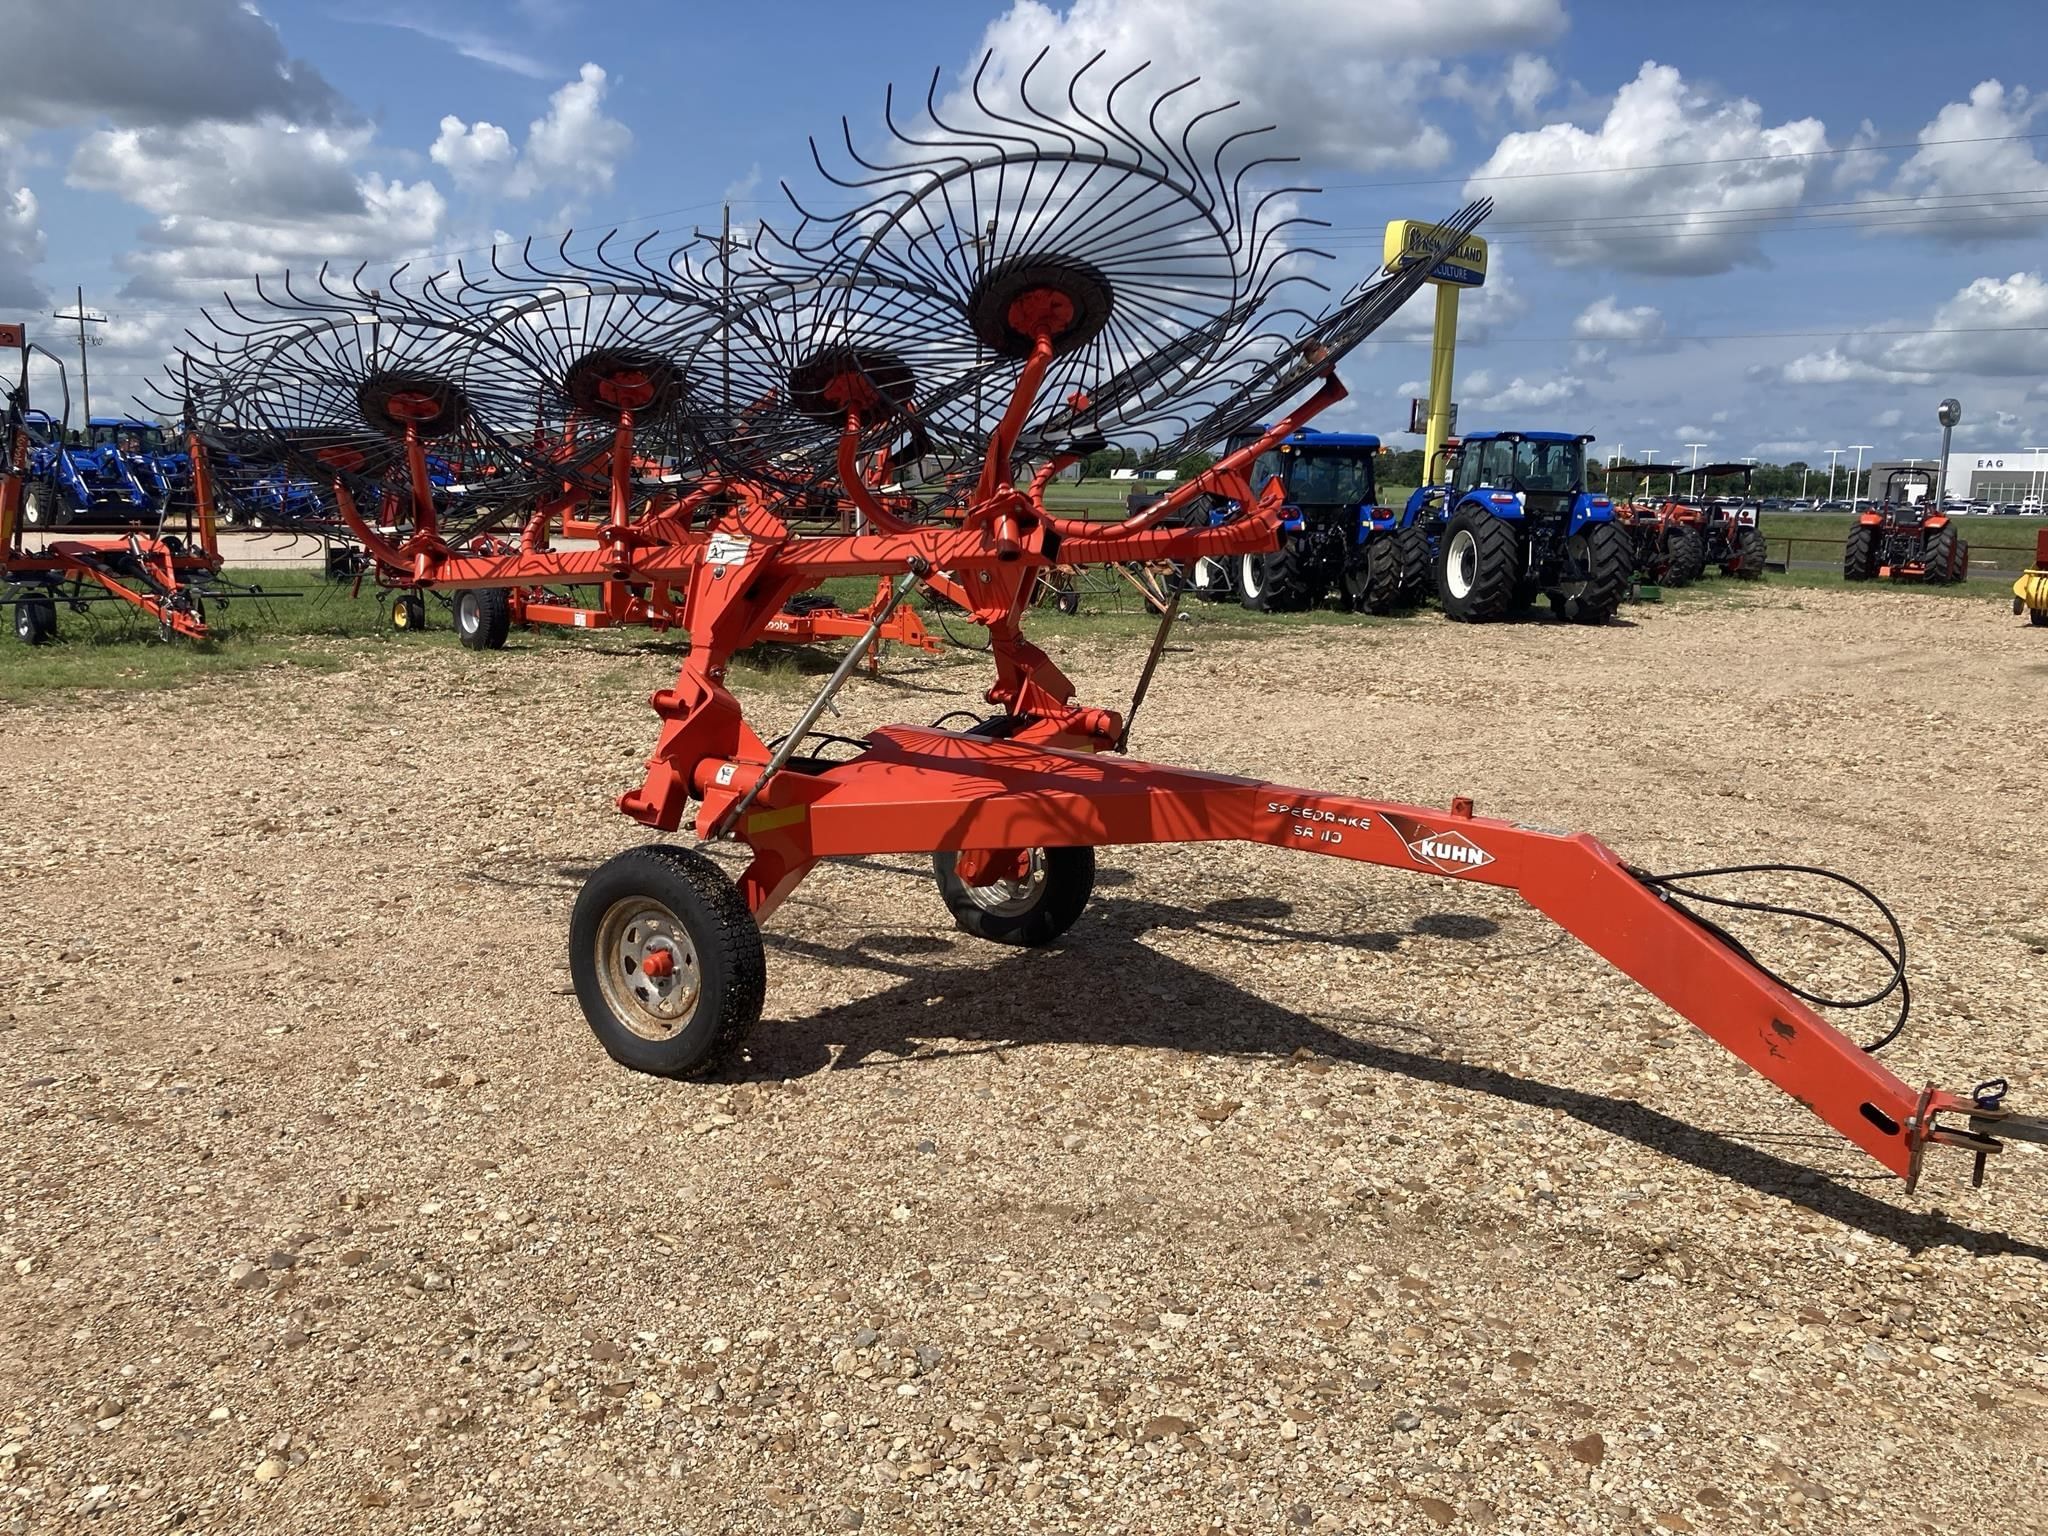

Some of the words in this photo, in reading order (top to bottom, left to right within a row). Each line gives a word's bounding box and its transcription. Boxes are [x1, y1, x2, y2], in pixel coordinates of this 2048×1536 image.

[1977, 459, 2004, 469] EAG
[1293, 825, 1314, 838] SR
[1320, 830, 1343, 844] 110
[1421, 839, 1484, 865] KUHN
